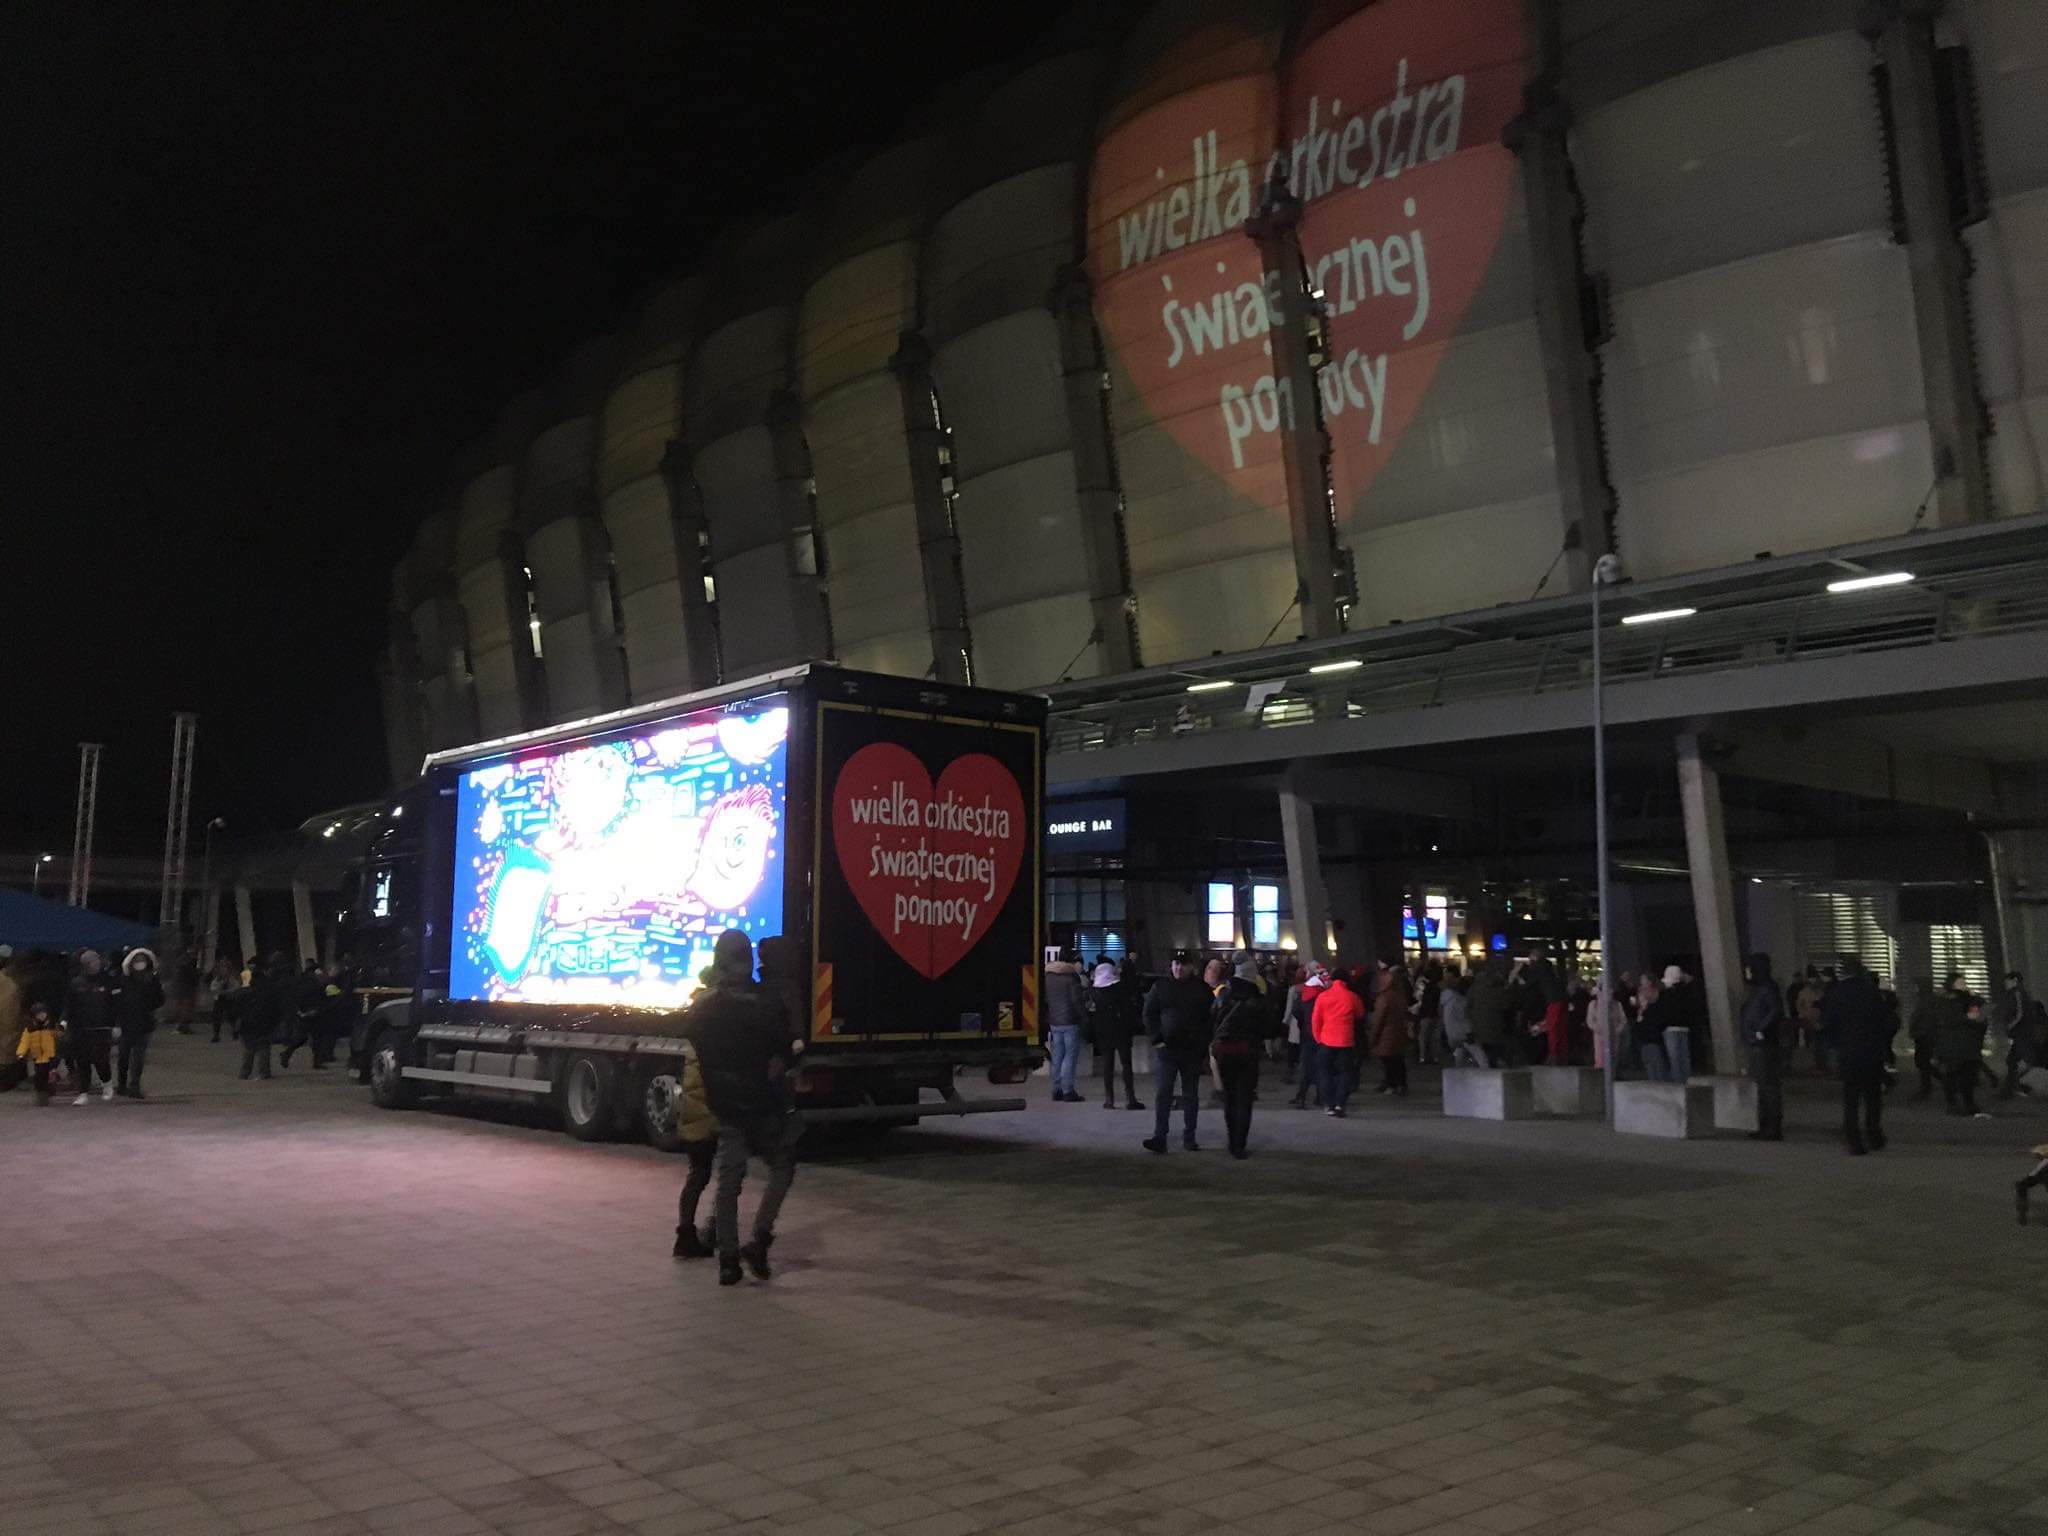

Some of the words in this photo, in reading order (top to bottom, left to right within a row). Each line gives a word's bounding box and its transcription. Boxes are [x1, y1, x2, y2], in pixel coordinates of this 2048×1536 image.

[1118, 130, 1251, 269] wielka
[851, 781, 919, 827] wielka
[925, 790, 1009, 838] orkiestra
[1047, 821, 1087, 835] OUNGE
[1092, 819, 1113, 832] BAR
[870, 833, 995, 902] świątecznej
[895, 893, 978, 941] pomocy
